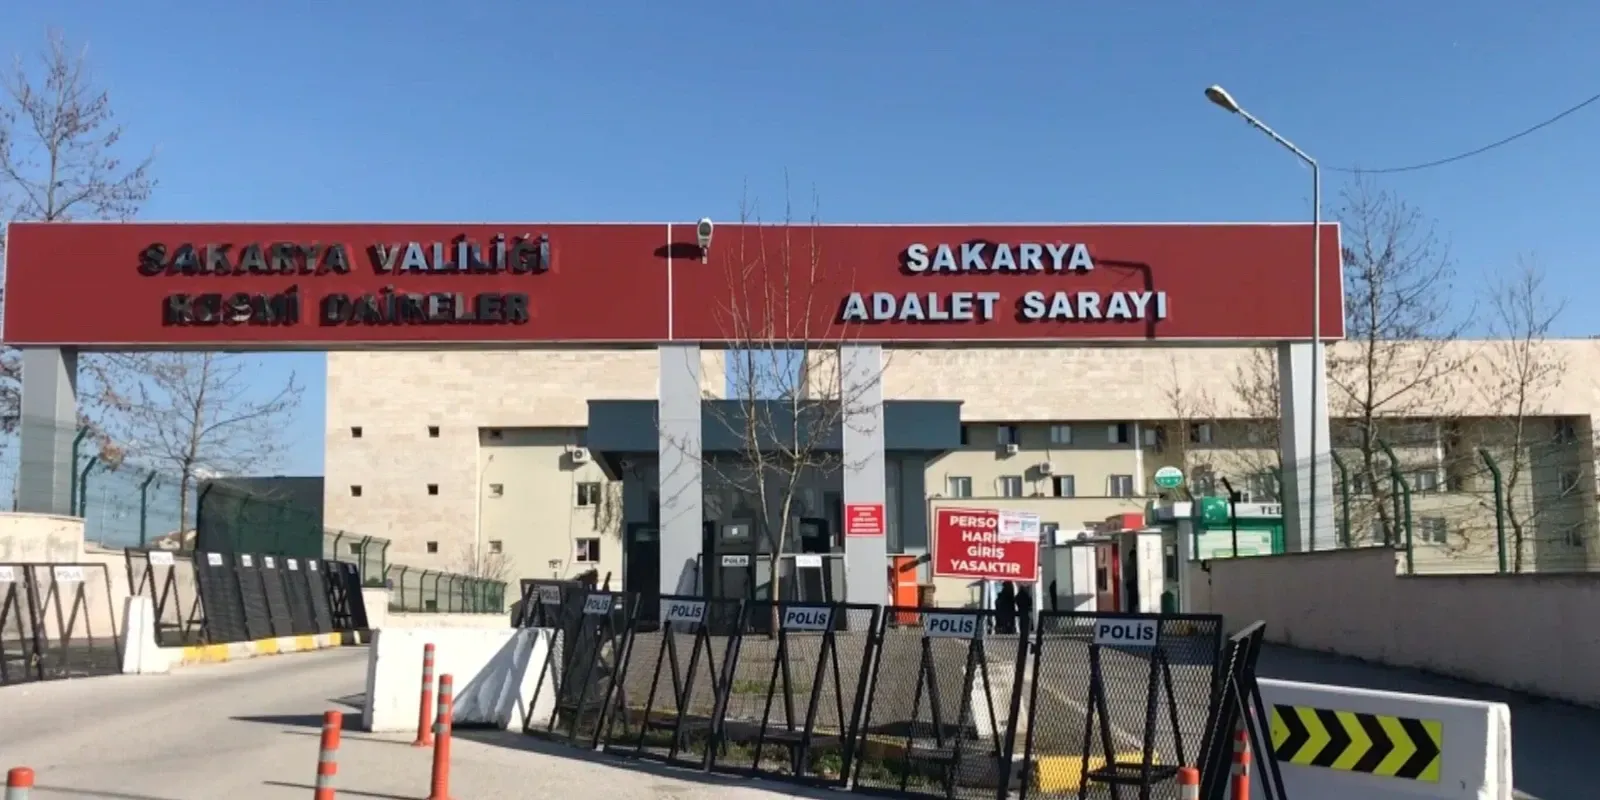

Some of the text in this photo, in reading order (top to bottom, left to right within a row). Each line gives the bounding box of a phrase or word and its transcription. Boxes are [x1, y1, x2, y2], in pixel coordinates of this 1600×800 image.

[139, 233, 550, 274] SAKARYA VALİLİĞİ
[906, 243, 1095, 272] SAKARYA
[319, 284, 530, 324] DAİRELER
[842, 290, 1168, 320] ADALET SARAYI
[949, 515, 997, 528] PERSO
[967, 543, 1005, 560] GİRİŞ
[950, 559, 1021, 574] YASAKTIR
[671, 602, 702, 619] POLİS
[787, 609, 827, 626] POLİS
[929, 614, 974, 634] POLİS
[1098, 619, 1154, 642] POLİS
